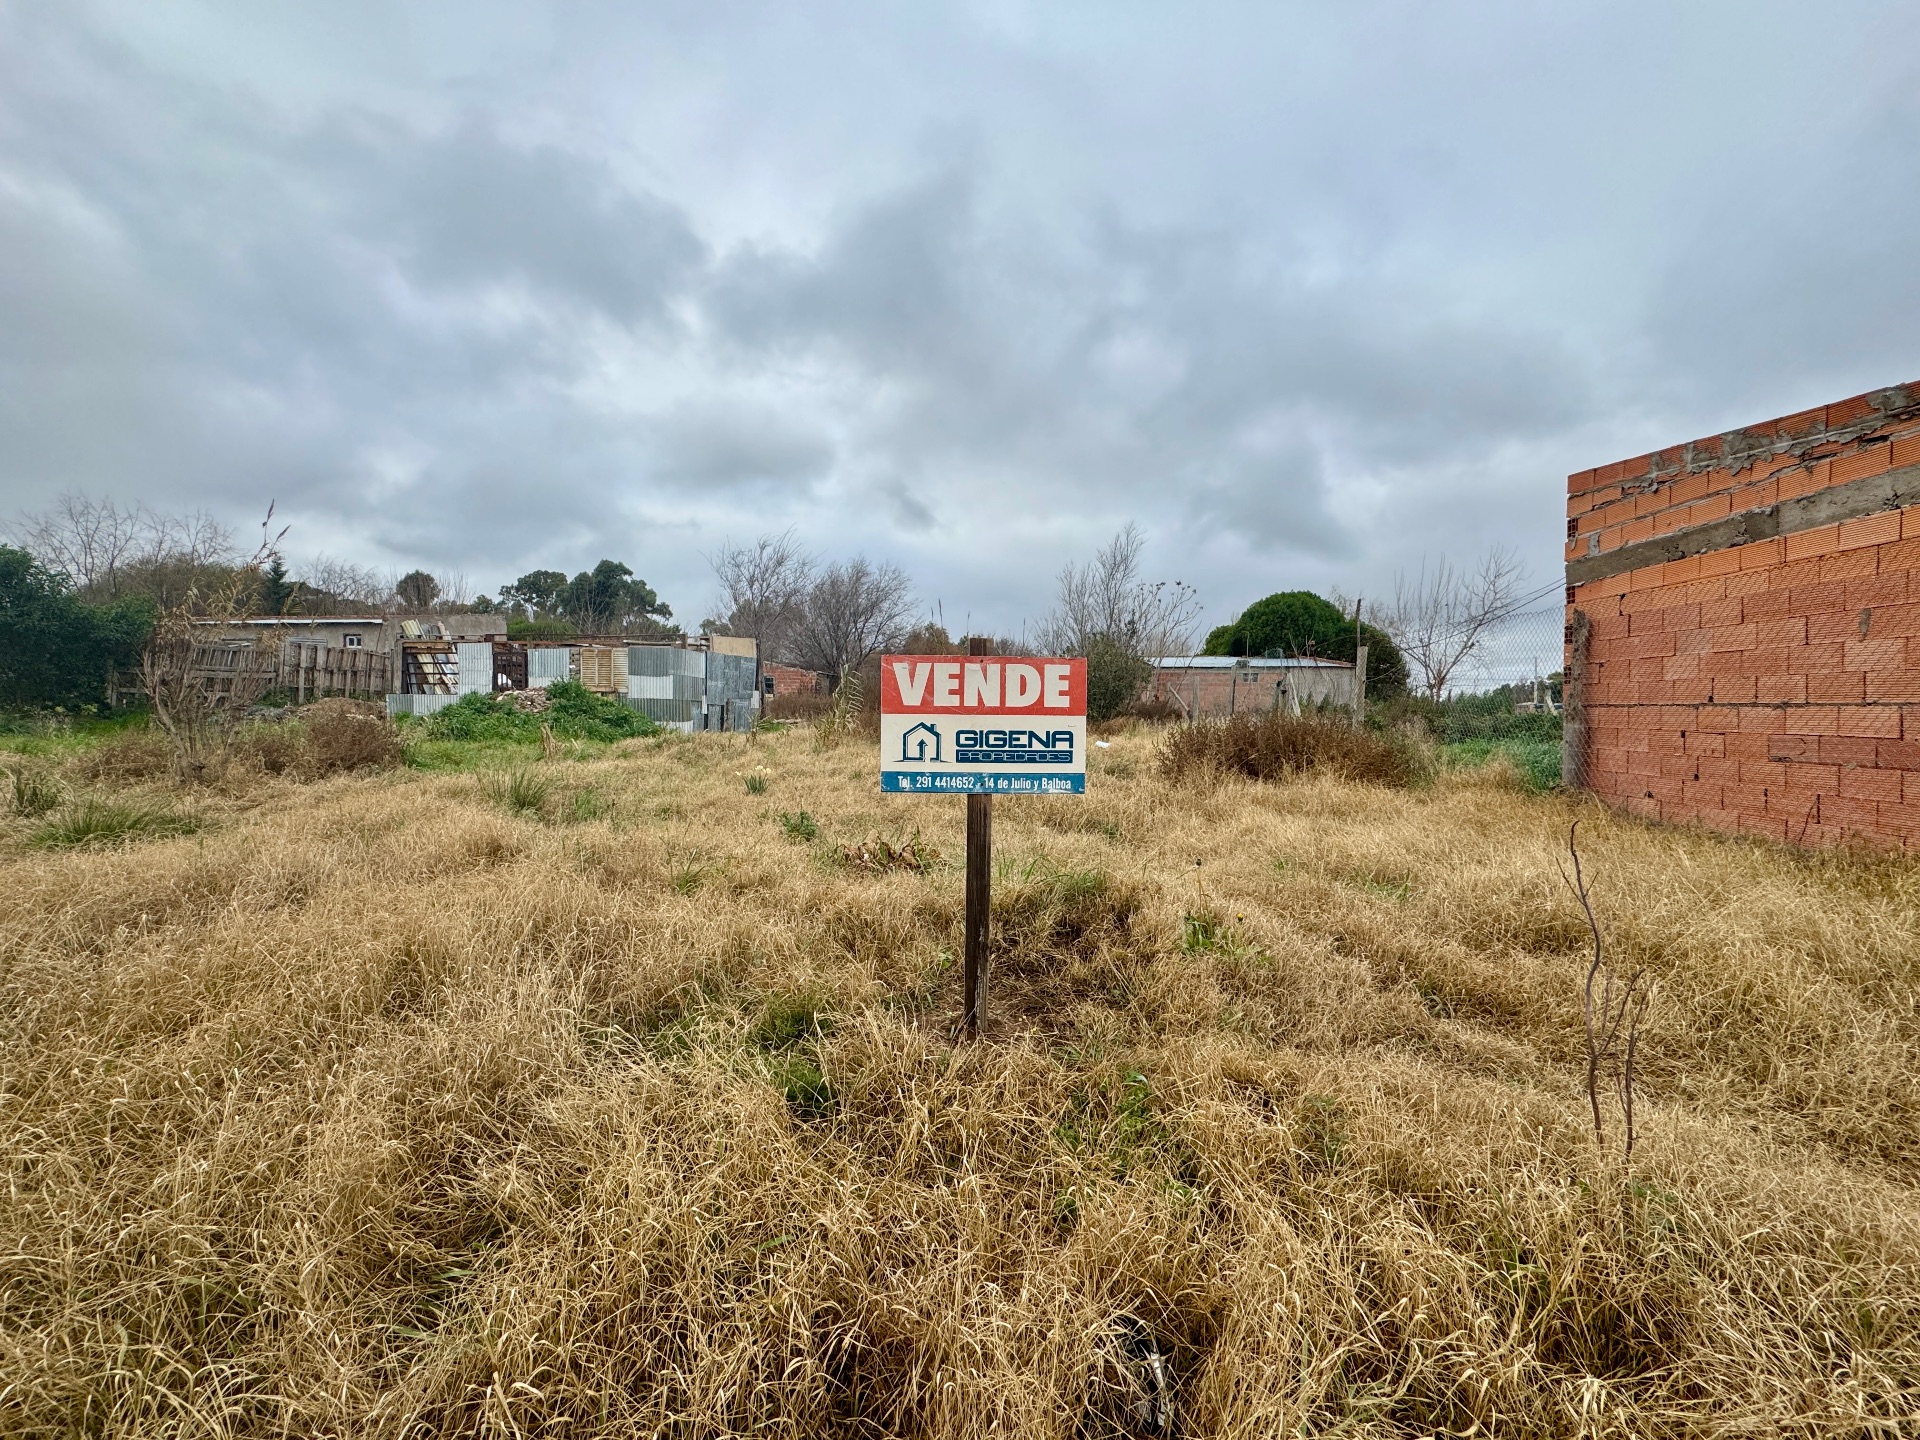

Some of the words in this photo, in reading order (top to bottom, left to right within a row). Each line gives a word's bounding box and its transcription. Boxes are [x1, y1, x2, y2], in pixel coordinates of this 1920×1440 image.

[893, 662, 1070, 708] VENDE
[955, 729, 1074, 749] GIGENA
[916, 776, 932, 788] 291
[934, 776, 974, 788] 4414652
[984, 777, 994, 789] 14
[997, 777, 1009, 789] de
[1010, 777, 1031, 790] Julio
[1032, 780, 1039, 791] y
[1041, 778, 1072, 790] Balboa
